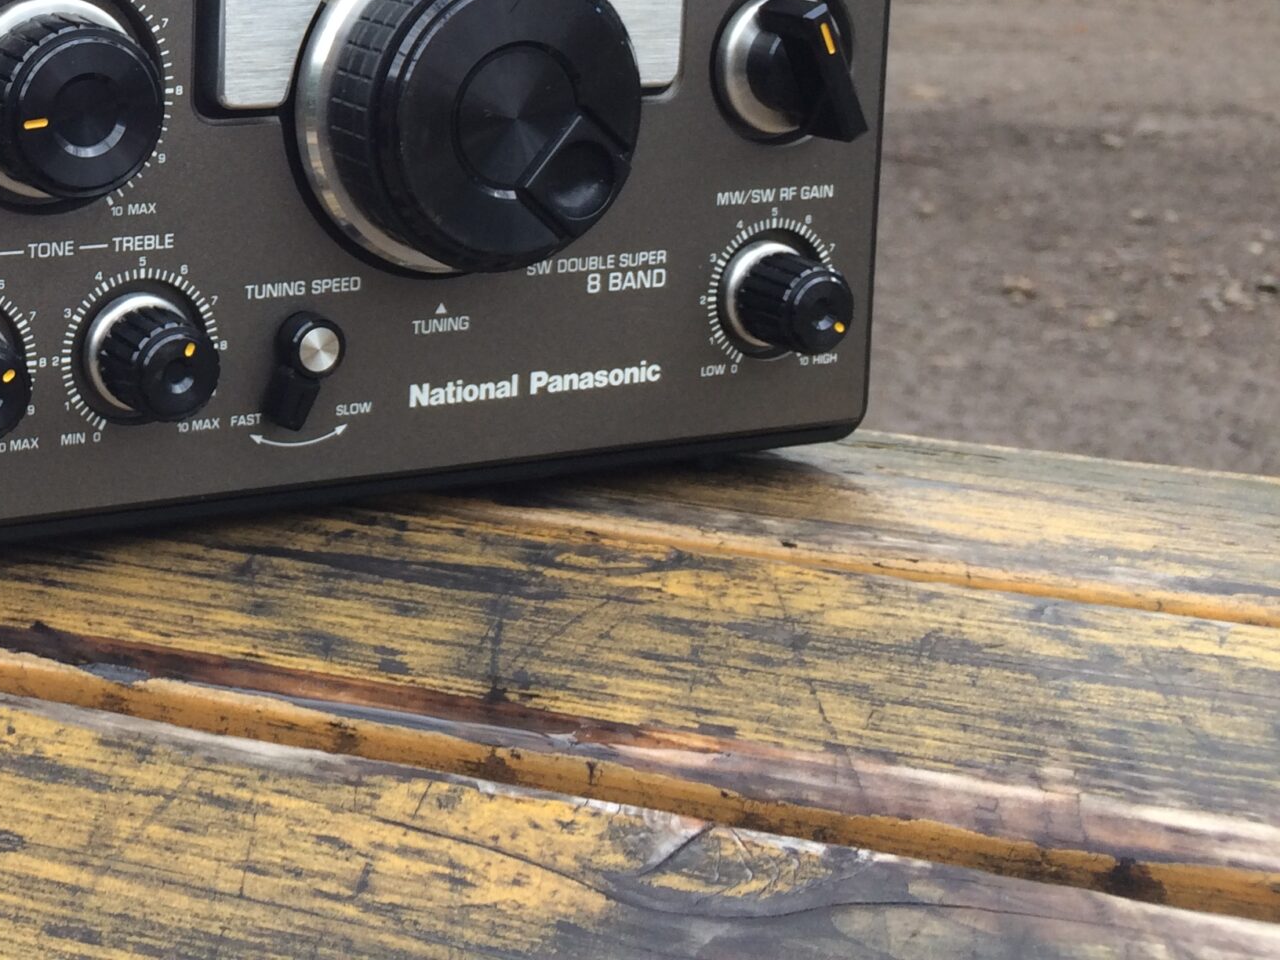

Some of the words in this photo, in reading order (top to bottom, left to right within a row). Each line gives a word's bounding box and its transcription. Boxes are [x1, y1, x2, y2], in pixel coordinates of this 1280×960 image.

[161, 18, 169, 28] 7
[175, 85, 183, 95] 8
[158, 153, 166, 163] 9
[717, 188, 776, 206] MW/SW
[779, 187, 798, 200] RF
[800, 184, 834, 199] GAIN
[111, 206, 123, 216] 10
[127, 202, 156, 215] MAX
[28, 241, 74, 259] TONE
[112, 233, 174, 252] TREBLE
[139, 256, 147, 267] 5
[526, 260, 553, 276] SW
[557, 254, 615, 273] DOUBLE
[619, 250, 667, 267] SUPER
[95, 271, 103, 281] 4
[180, 265, 189, 275] 6
[587, 273, 601, 294] 8
[608, 268, 666, 291] BAND
[245, 280, 306, 300] TUNING
[311, 276, 361, 295] SPEED
[64, 308, 72, 318] 3
[412, 316, 470, 335] TUNING
[52, 356, 60, 367] 2
[812, 353, 838, 365] HIGH
[700, 364, 726, 377] LOW
[409, 374, 519, 407] National
[529, 360, 661, 395] Panasonic
[335, 401, 372, 416] SLOW
[177, 422, 189, 432] 10
[191, 418, 220, 431] MAX
[230, 413, 262, 427] FAST
[10, 438, 39, 451] MAX
[60, 433, 85, 446] MIN
